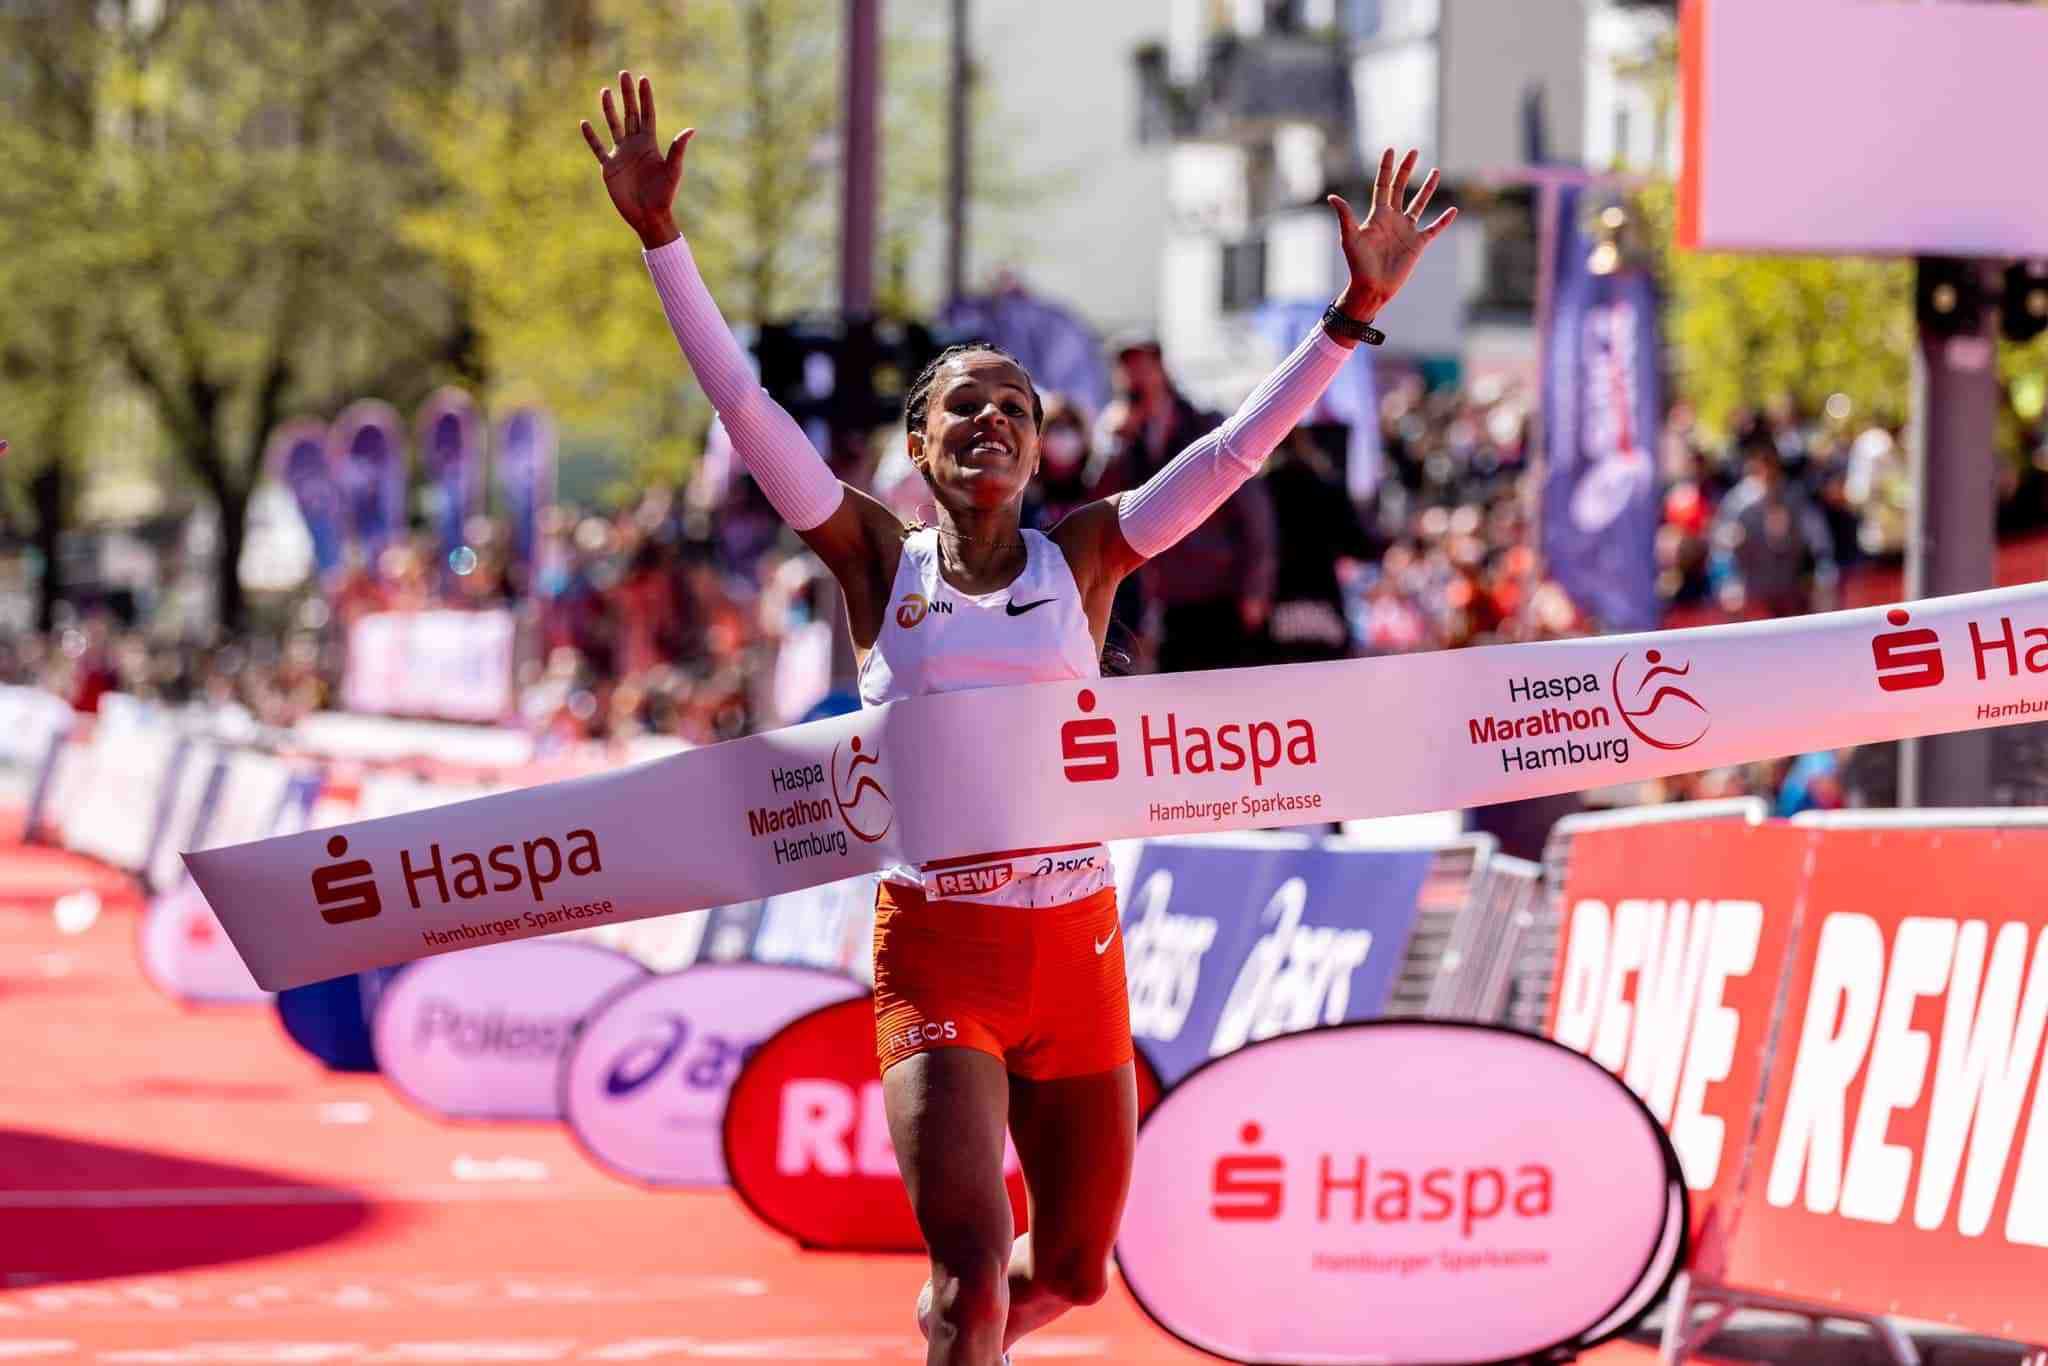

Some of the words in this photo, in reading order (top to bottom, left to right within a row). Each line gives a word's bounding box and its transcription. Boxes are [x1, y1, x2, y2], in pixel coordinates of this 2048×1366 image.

[1510, 673, 1600, 702] Haspa
[1469, 706, 1610, 744] Marathon
[1141, 713, 1316, 785] Haspa
[1502, 738, 1629, 772] Hamburg
[772, 763, 824, 792] Haspa
[749, 798, 832, 836] Marathon
[1150, 800, 1238, 822] Hamburger
[1241, 792, 1321, 817] Sparkasse
[774, 830, 847, 864] Hamburg
[400, 829, 602, 909] Haspa
[939, 865, 1010, 894] REWE
[423, 916, 521, 946] Hamburger
[523, 900, 613, 927] Sparkasse
[1767, 912, 2048, 1248] REW
[1316, 1153, 1554, 1238] Haspa
